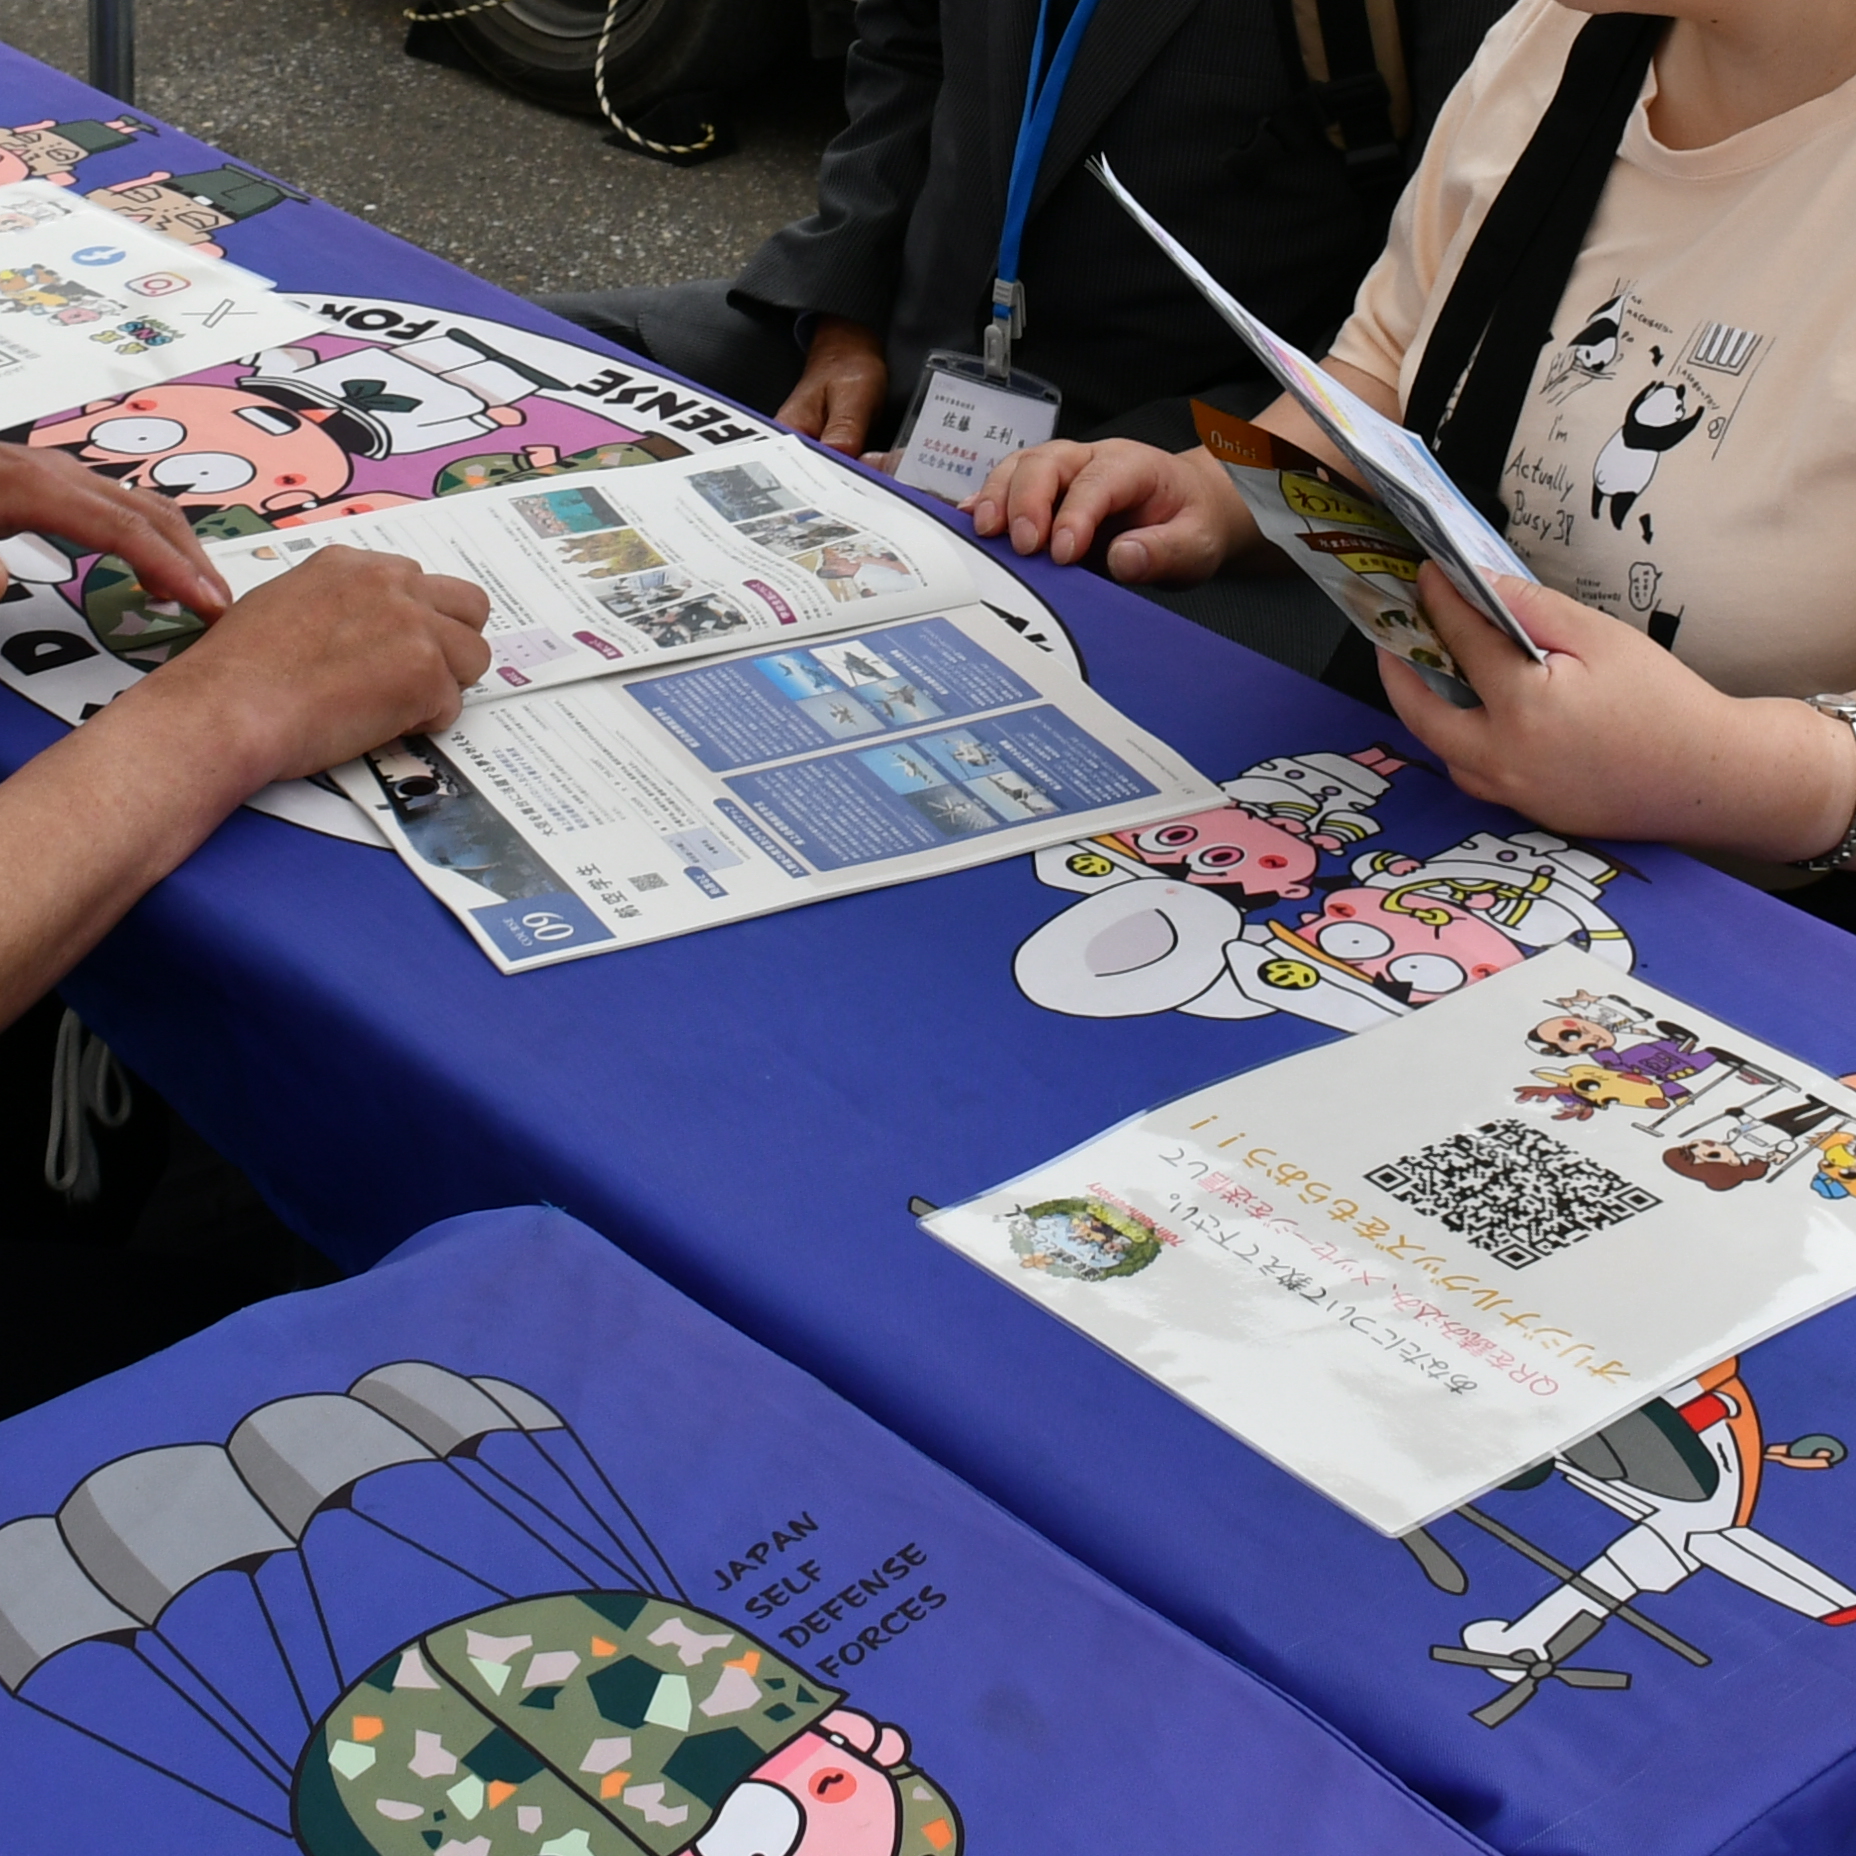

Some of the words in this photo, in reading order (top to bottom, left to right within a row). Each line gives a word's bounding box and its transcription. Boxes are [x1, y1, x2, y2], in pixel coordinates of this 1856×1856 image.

[1548, 414, 1568, 442] I'm
[1505, 447, 1574, 503] Actually
[516, 906, 581, 944] 09
[571, 862, 645, 920] 航空学生
[1156, 1145, 1561, 1398] QRを読み込み、メッセージを送信して
[1189, 1114, 1632, 1385] オリジナルグッズをもらおう！！
[1166, 1189, 1479, 1396] あなたについて教えて下さい。
[713, 1510, 820, 1593] JAPAN
[744, 1558, 824, 1621] SELF
[778, 1541, 929, 1650] DEFENSE
[815, 1583, 948, 1679] FORCES
